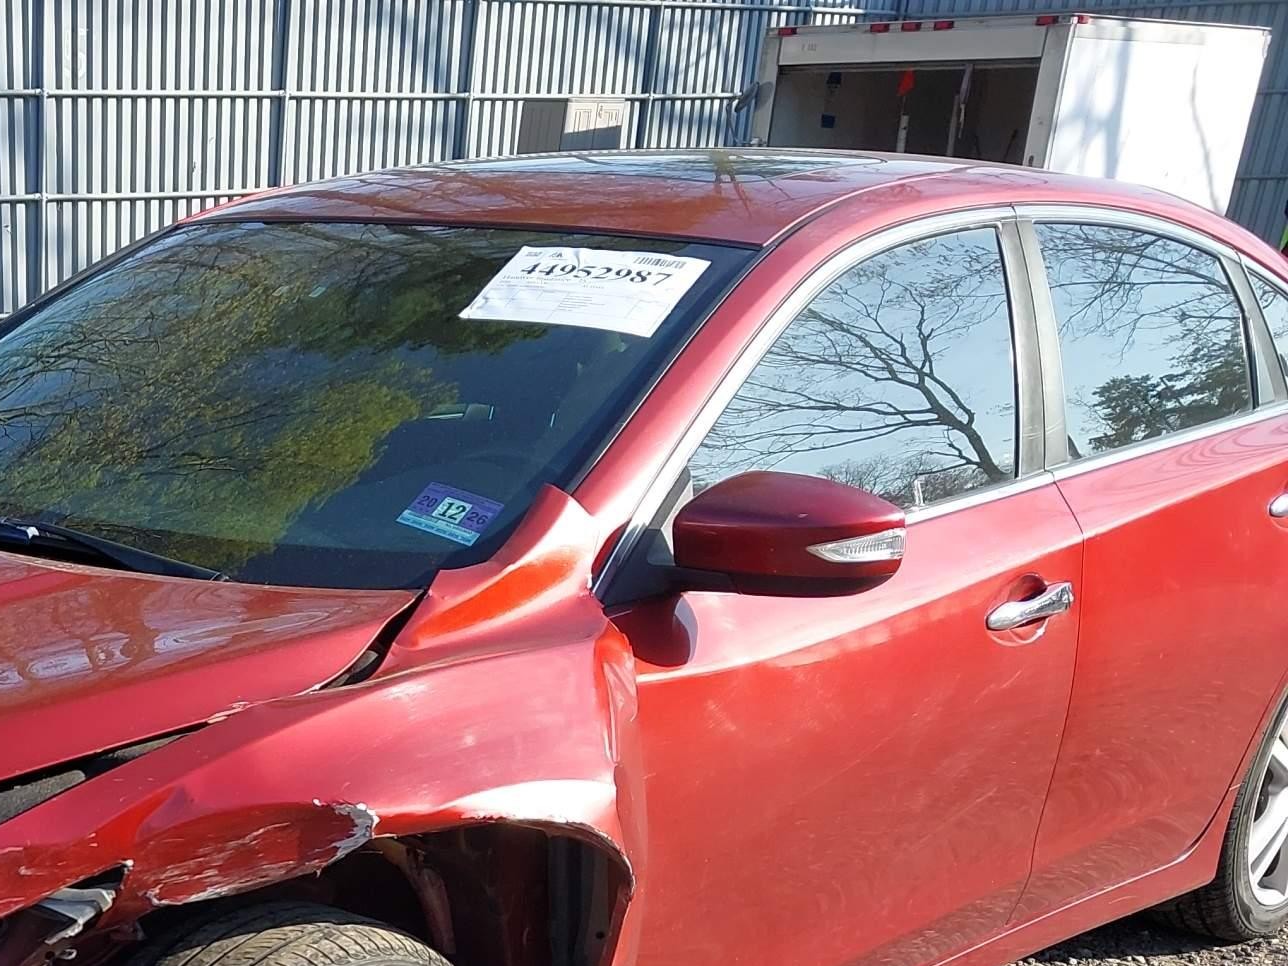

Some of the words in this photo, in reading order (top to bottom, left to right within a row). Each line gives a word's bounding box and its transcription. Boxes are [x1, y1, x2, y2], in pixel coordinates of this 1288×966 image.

[520, 262, 673, 286] 44952987
[416, 495, 438, 508] 20
[438, 502, 467, 521] 12
[466, 511, 489, 525] 26
